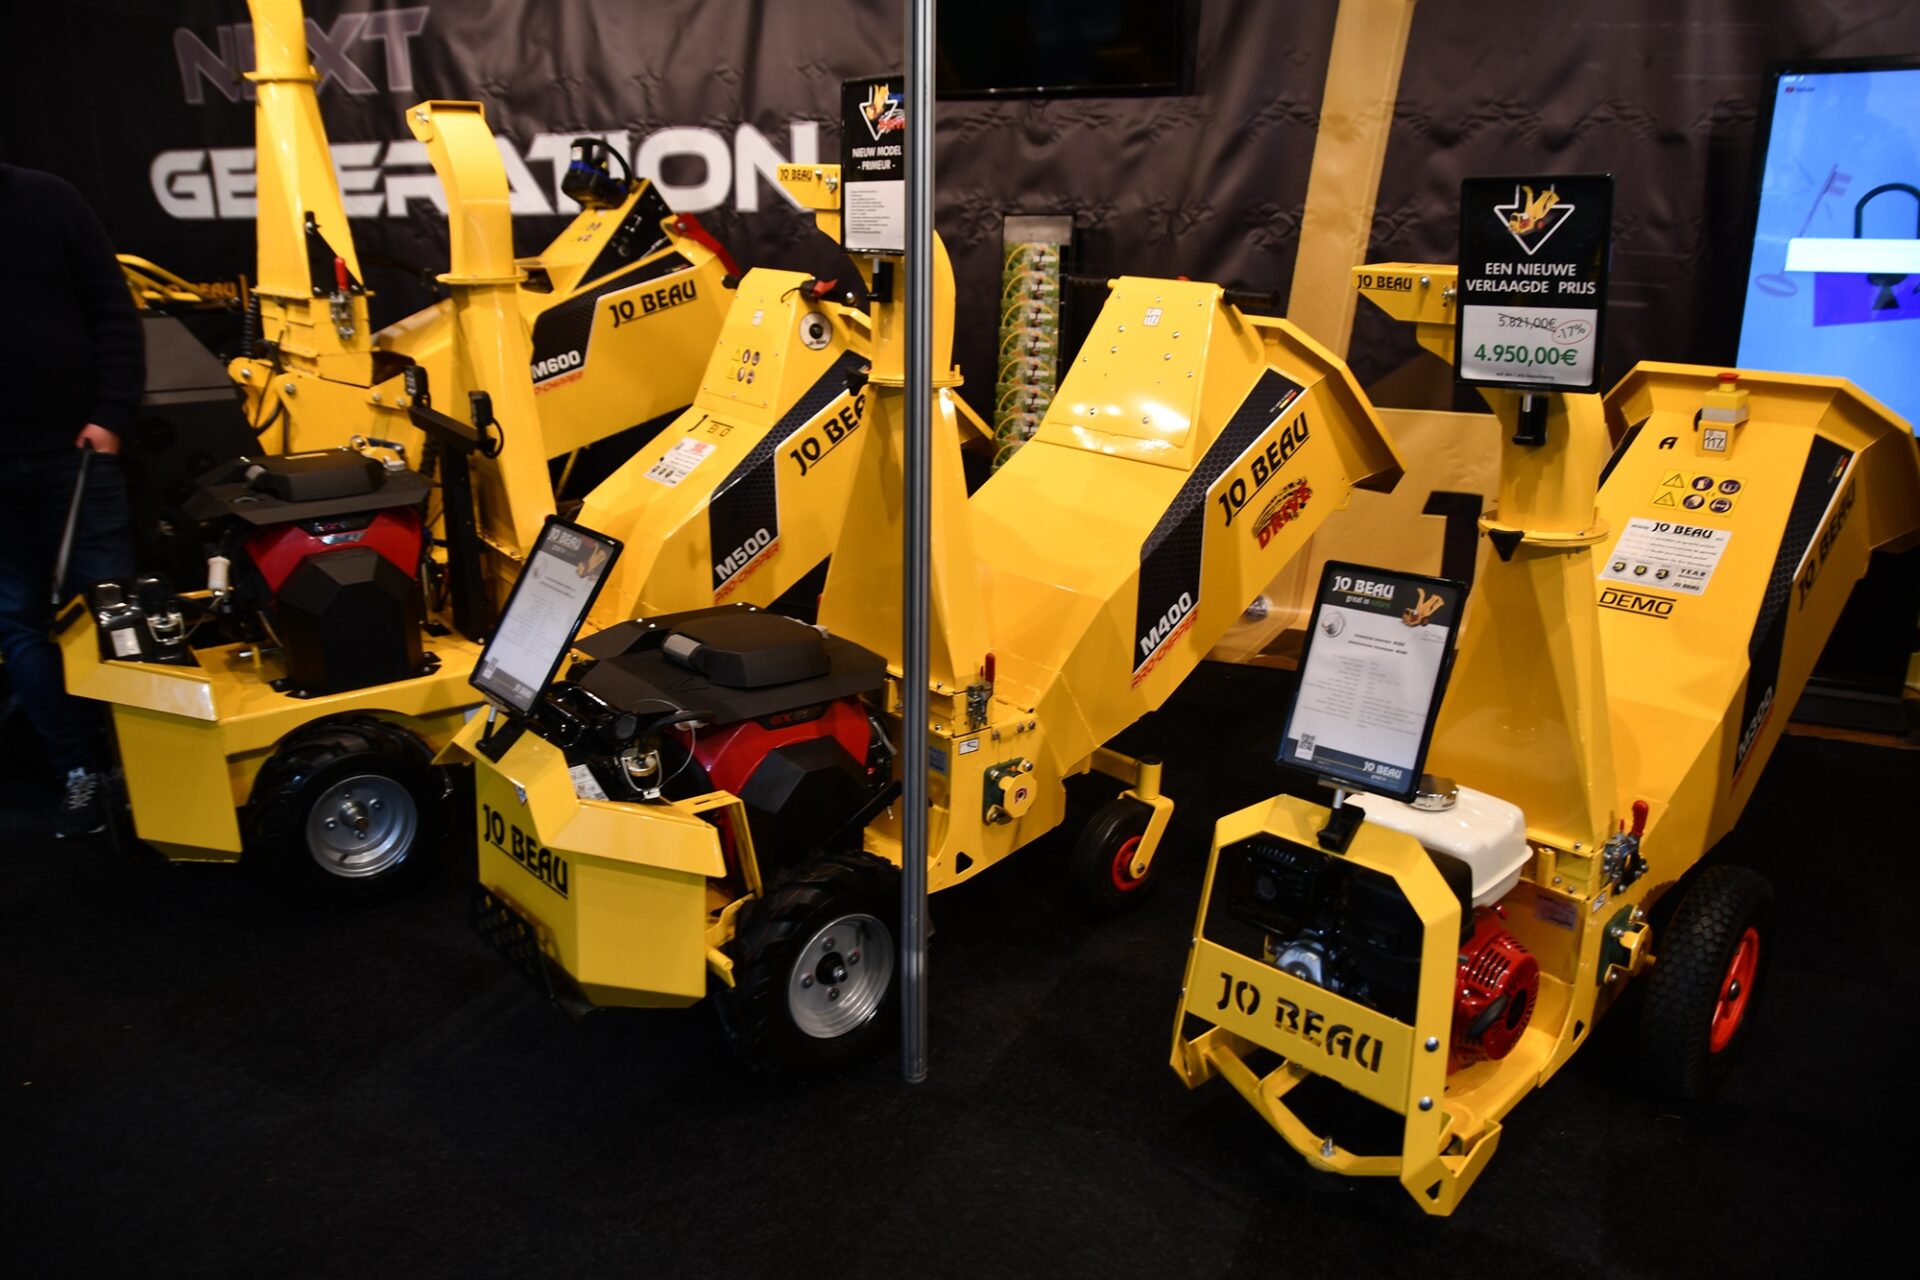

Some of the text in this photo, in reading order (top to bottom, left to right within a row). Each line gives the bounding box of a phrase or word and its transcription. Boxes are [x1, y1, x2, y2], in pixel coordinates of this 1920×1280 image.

[852, 145, 902, 158] NIEUW MODEL
[151, 121, 819, 219] GEERATION
[780, 169, 812, 181] JO BEAU
[861, 160, 891, 171] PRIMEUR
[1485, 262, 1577, 277] EEN NIEUWE
[1357, 274, 1412, 290] JO BEAU
[1465, 279, 1597, 295] VERLAAGDE PRIJS
[609, 280, 697, 329] JO BEAU
[532, 349, 582, 379] M600
[1474, 344, 1578, 367] 4.950,00€
[790, 393, 866, 477] JO BEA
[1219, 477, 1247, 528] JO
[1251, 411, 1310, 488] BEAU
[1652, 521, 1671, 532] JO
[1673, 525, 1714, 539] BEAU
[714, 527, 771, 581] M500
[1680, 568, 1707, 578] YEAR
[1332, 575, 1396, 598] JO BEAU
[1598, 590, 1674, 616] DEMO
[1140, 591, 1192, 656] M400
[1362, 761, 1375, 772] JO
[1376, 765, 1403, 780] BEAU
[483, 803, 569, 895] JO BEAU
[1216, 972, 1384, 1074] JO BEAU
